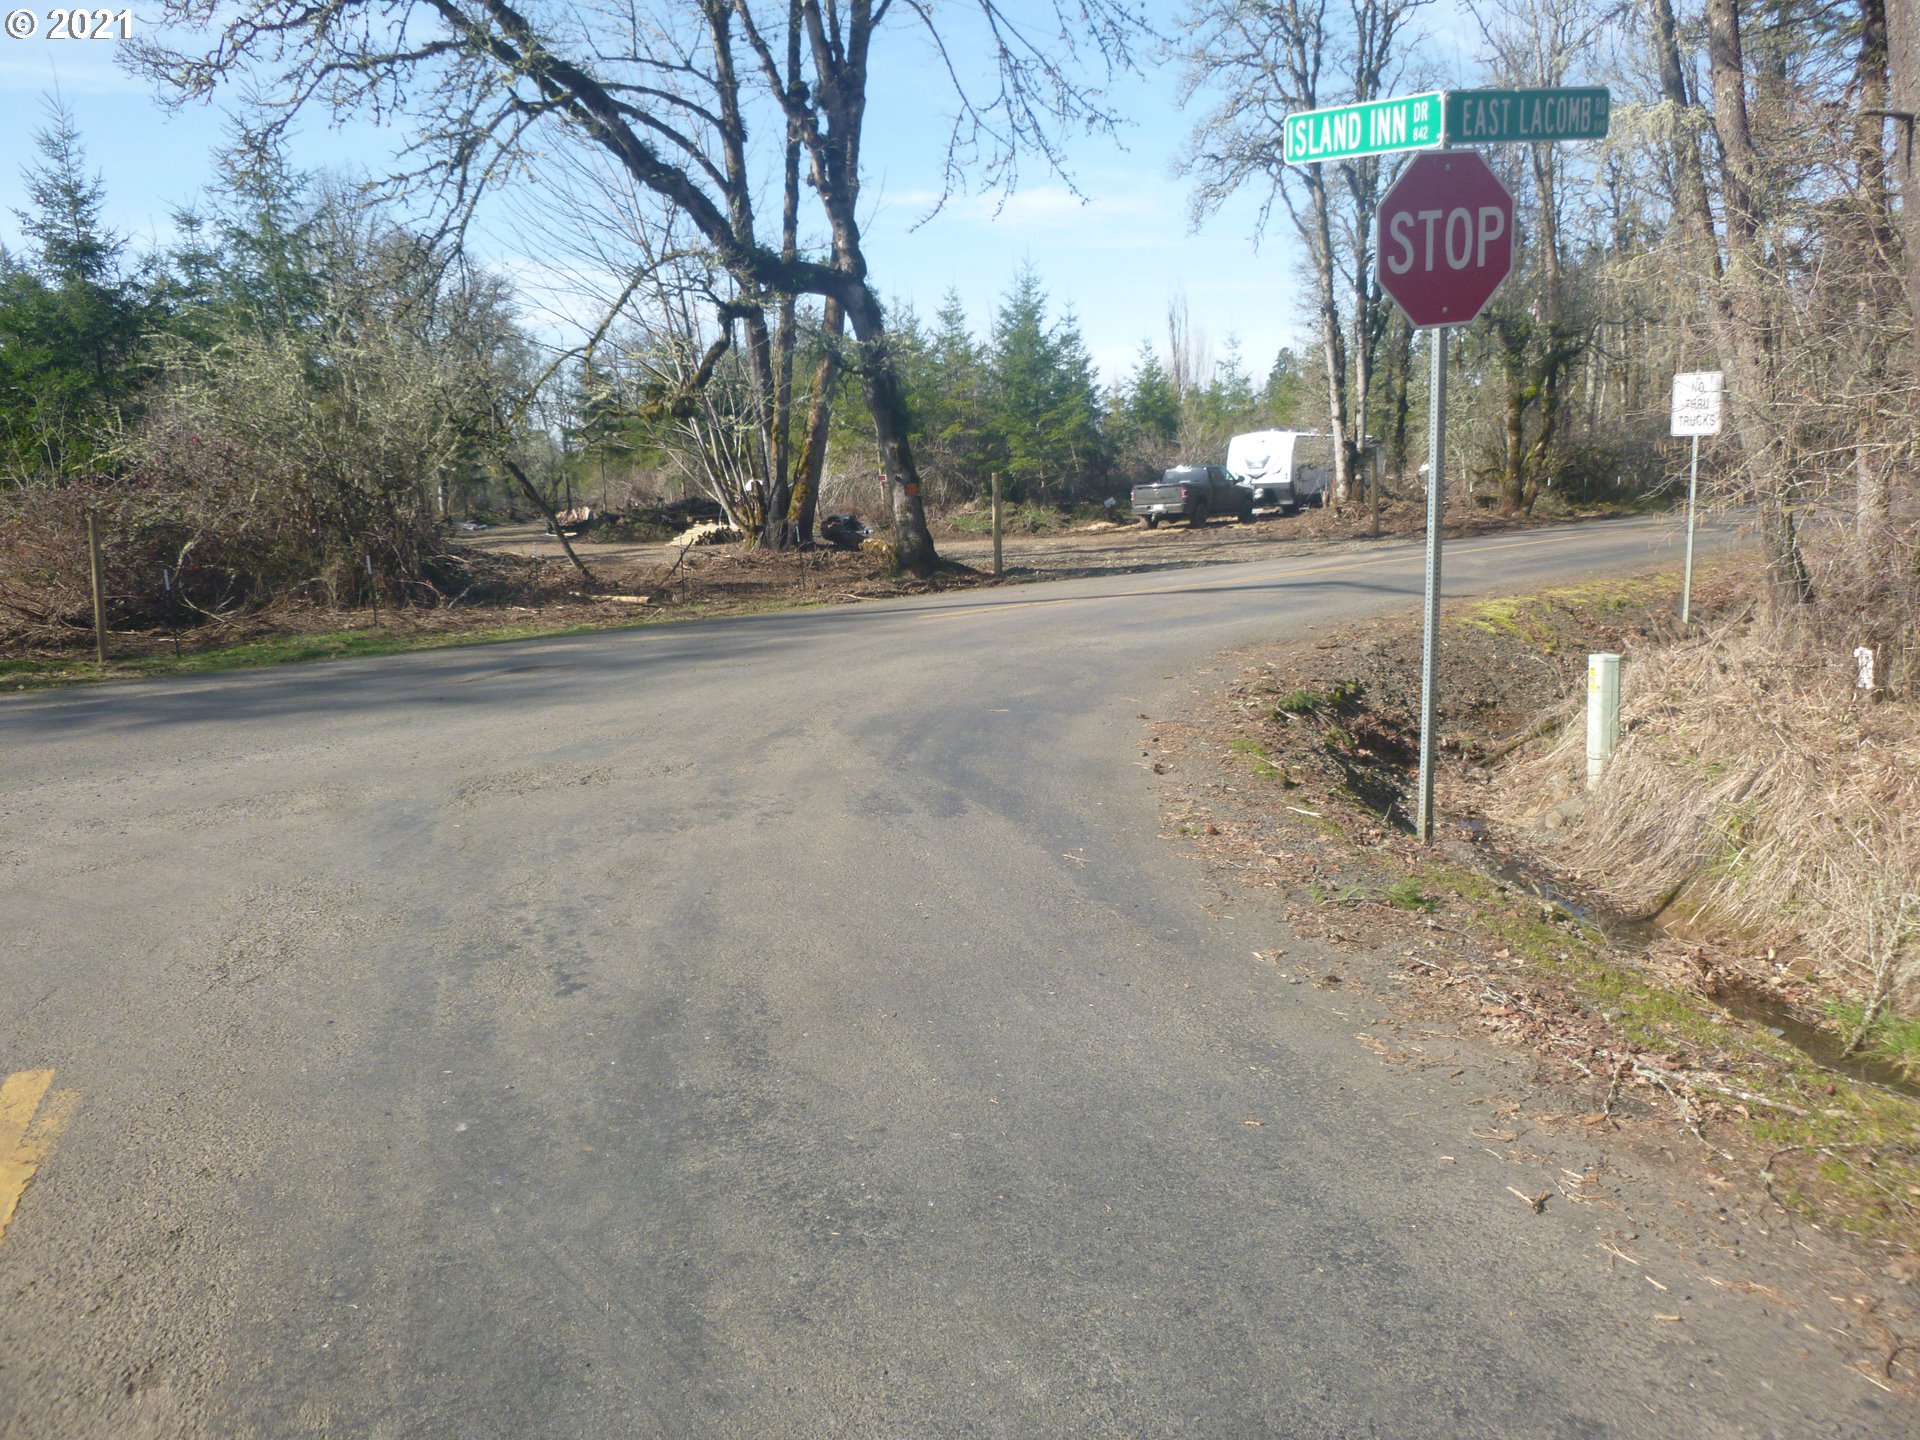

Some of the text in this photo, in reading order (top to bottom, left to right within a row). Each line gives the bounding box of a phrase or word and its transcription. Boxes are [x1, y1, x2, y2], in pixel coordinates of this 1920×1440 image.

[1288, 101, 1428, 157] ISLAND INN DR
[1463, 98, 1510, 136] EAST
[1520, 96, 1591, 134] LACOMB
[1413, 126, 1428, 142] 842
[1387, 206, 1505, 275] STOP
[1691, 381, 1705, 393] NO
[1679, 414, 1716, 427] TRUCKS
